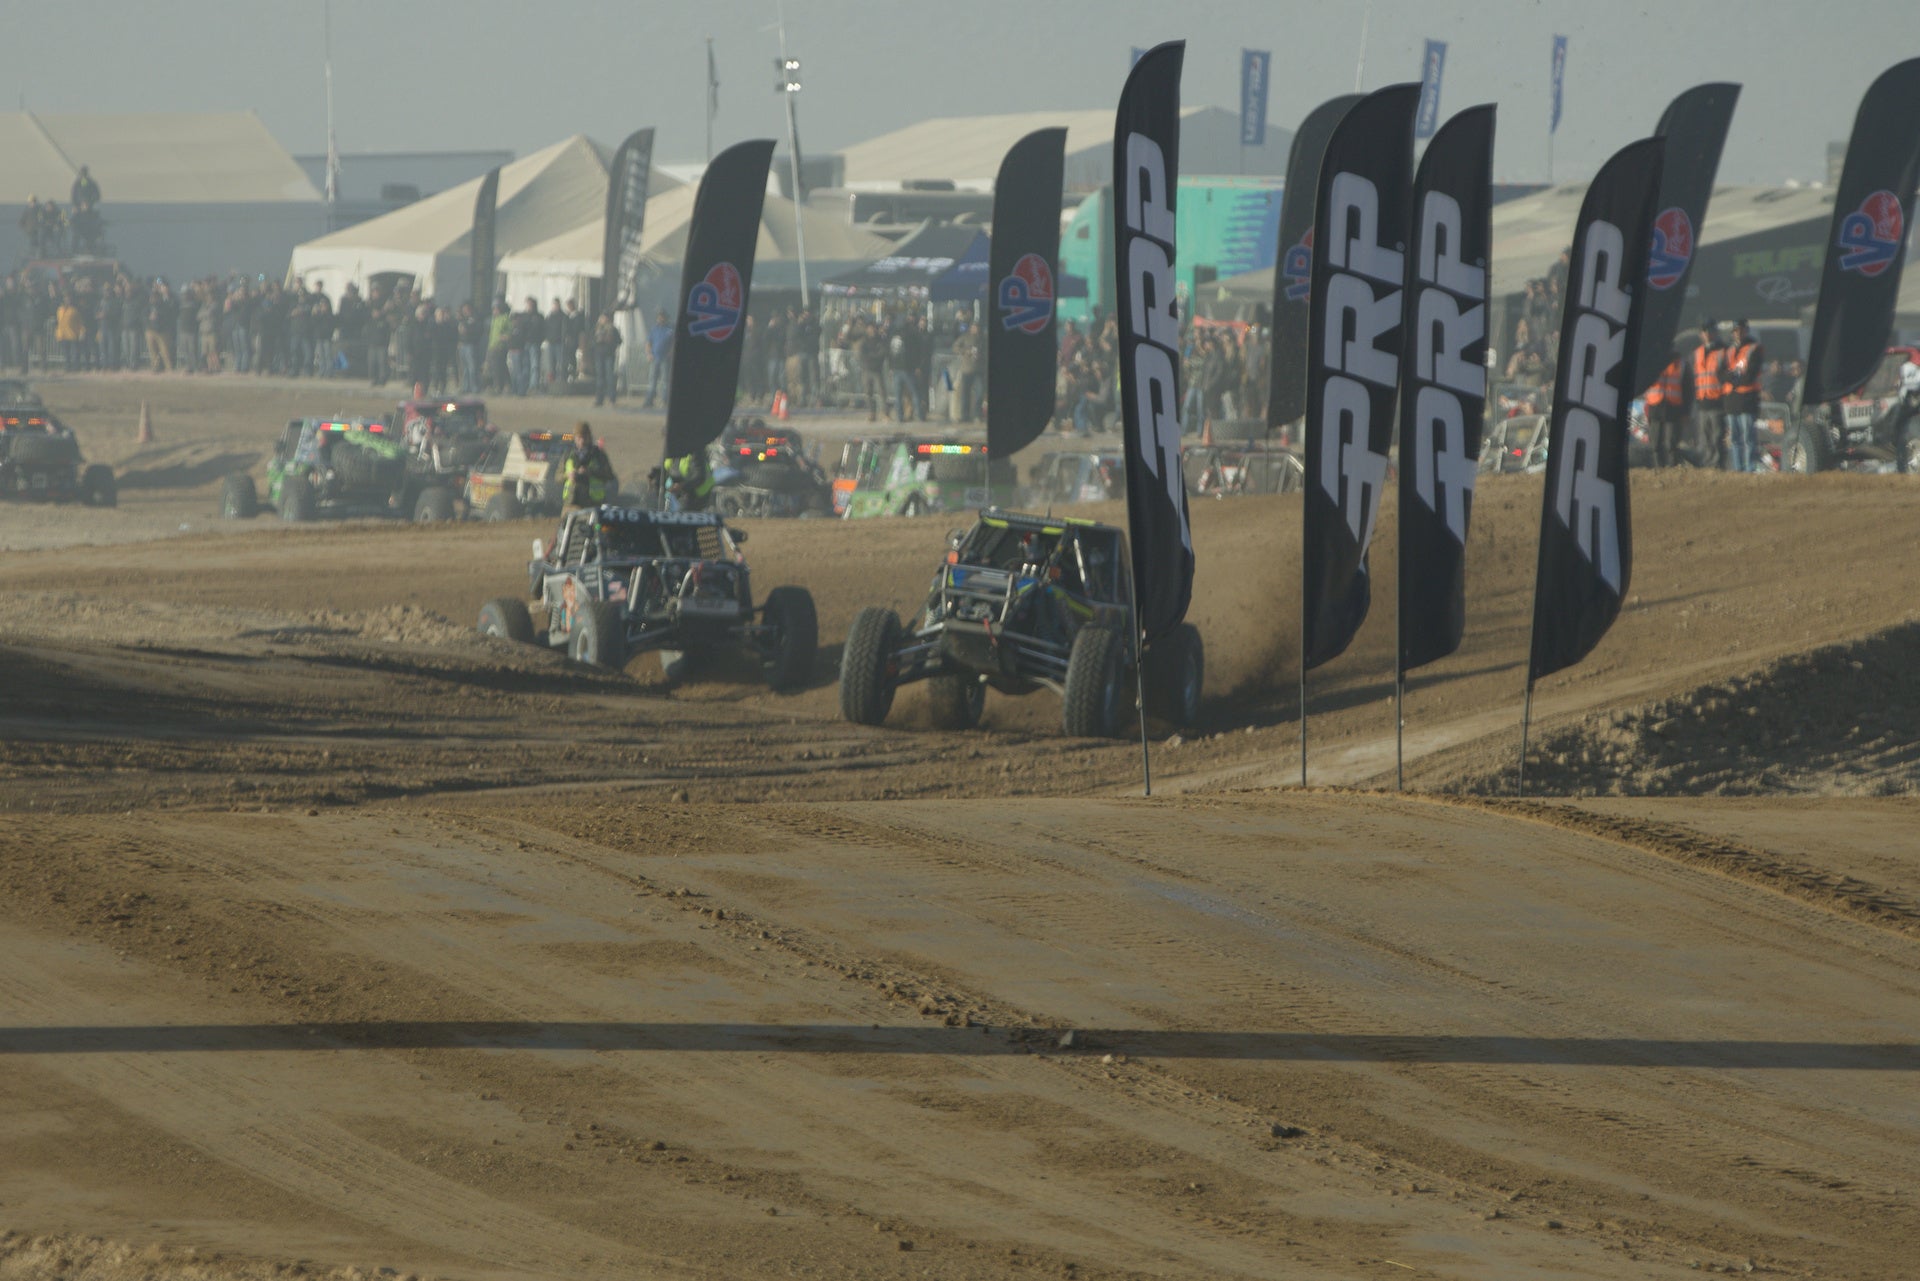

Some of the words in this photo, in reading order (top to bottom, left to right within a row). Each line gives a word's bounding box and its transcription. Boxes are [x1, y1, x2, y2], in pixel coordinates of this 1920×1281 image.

[687, 281, 741, 337] VP
[999, 275, 1053, 331] VP
[1126, 131, 1192, 553] PRP
[1839, 211, 1897, 270] VP
[1321, 171, 1403, 570] PRP
[1416, 190, 1485, 546] PRP
[1556, 219, 1631, 596] PRP
[603, 508, 640, 522] 416
